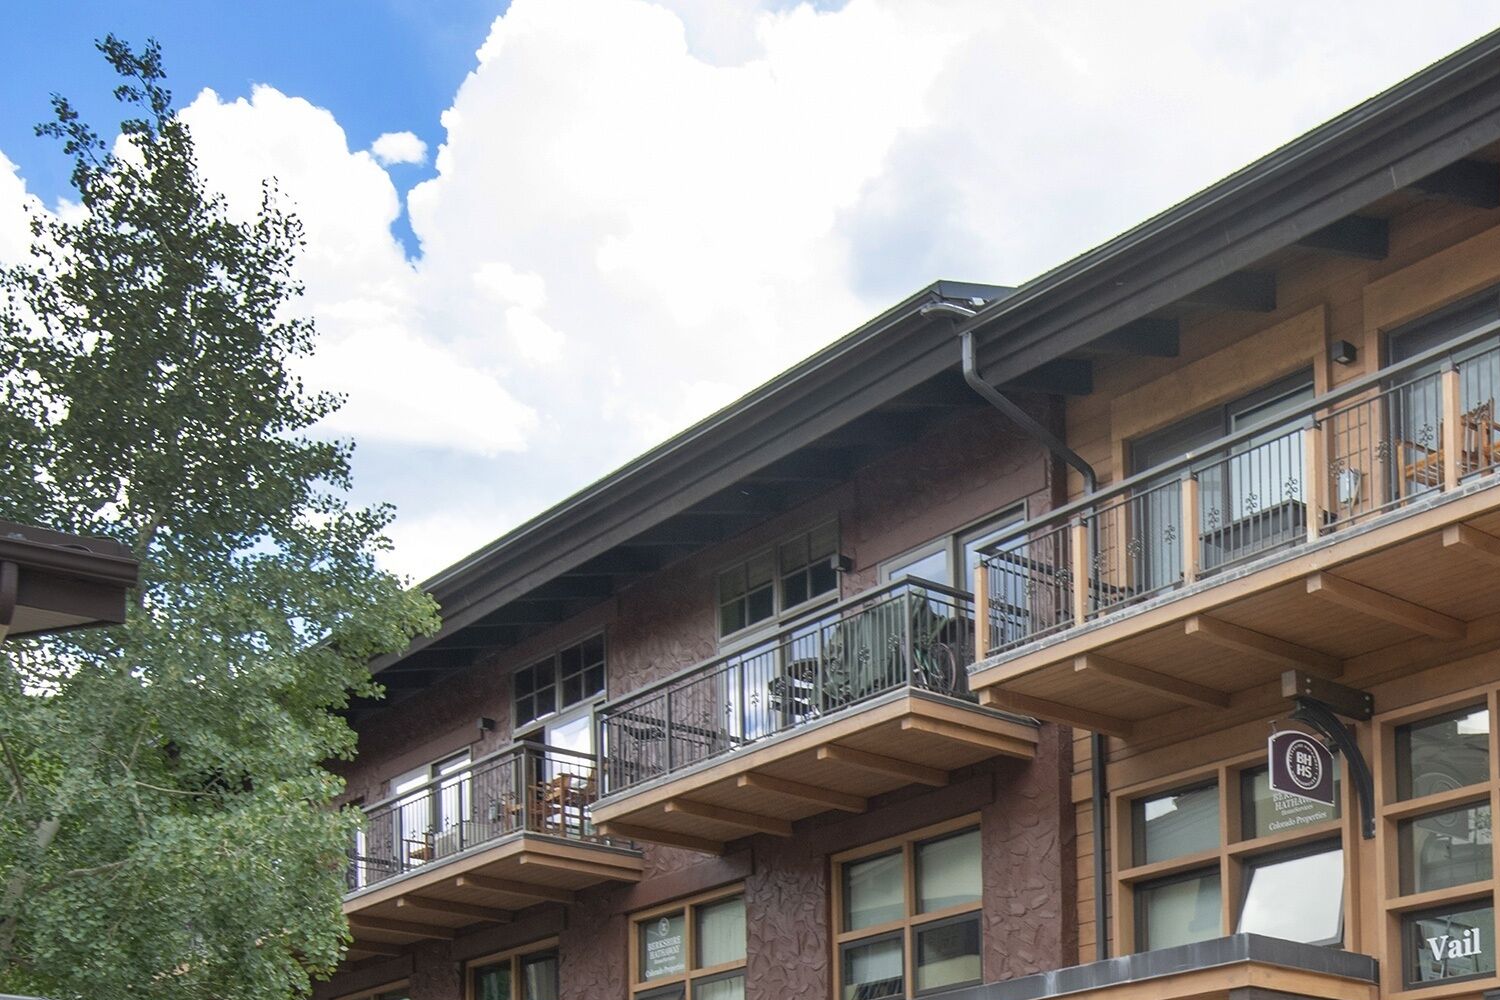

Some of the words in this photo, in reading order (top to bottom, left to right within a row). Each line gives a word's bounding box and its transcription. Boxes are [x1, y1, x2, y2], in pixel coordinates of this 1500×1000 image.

[1296, 752, 1312, 767] BH
[1296, 764, 1312, 779] HS
[1427, 928, 1482, 962] Vail
